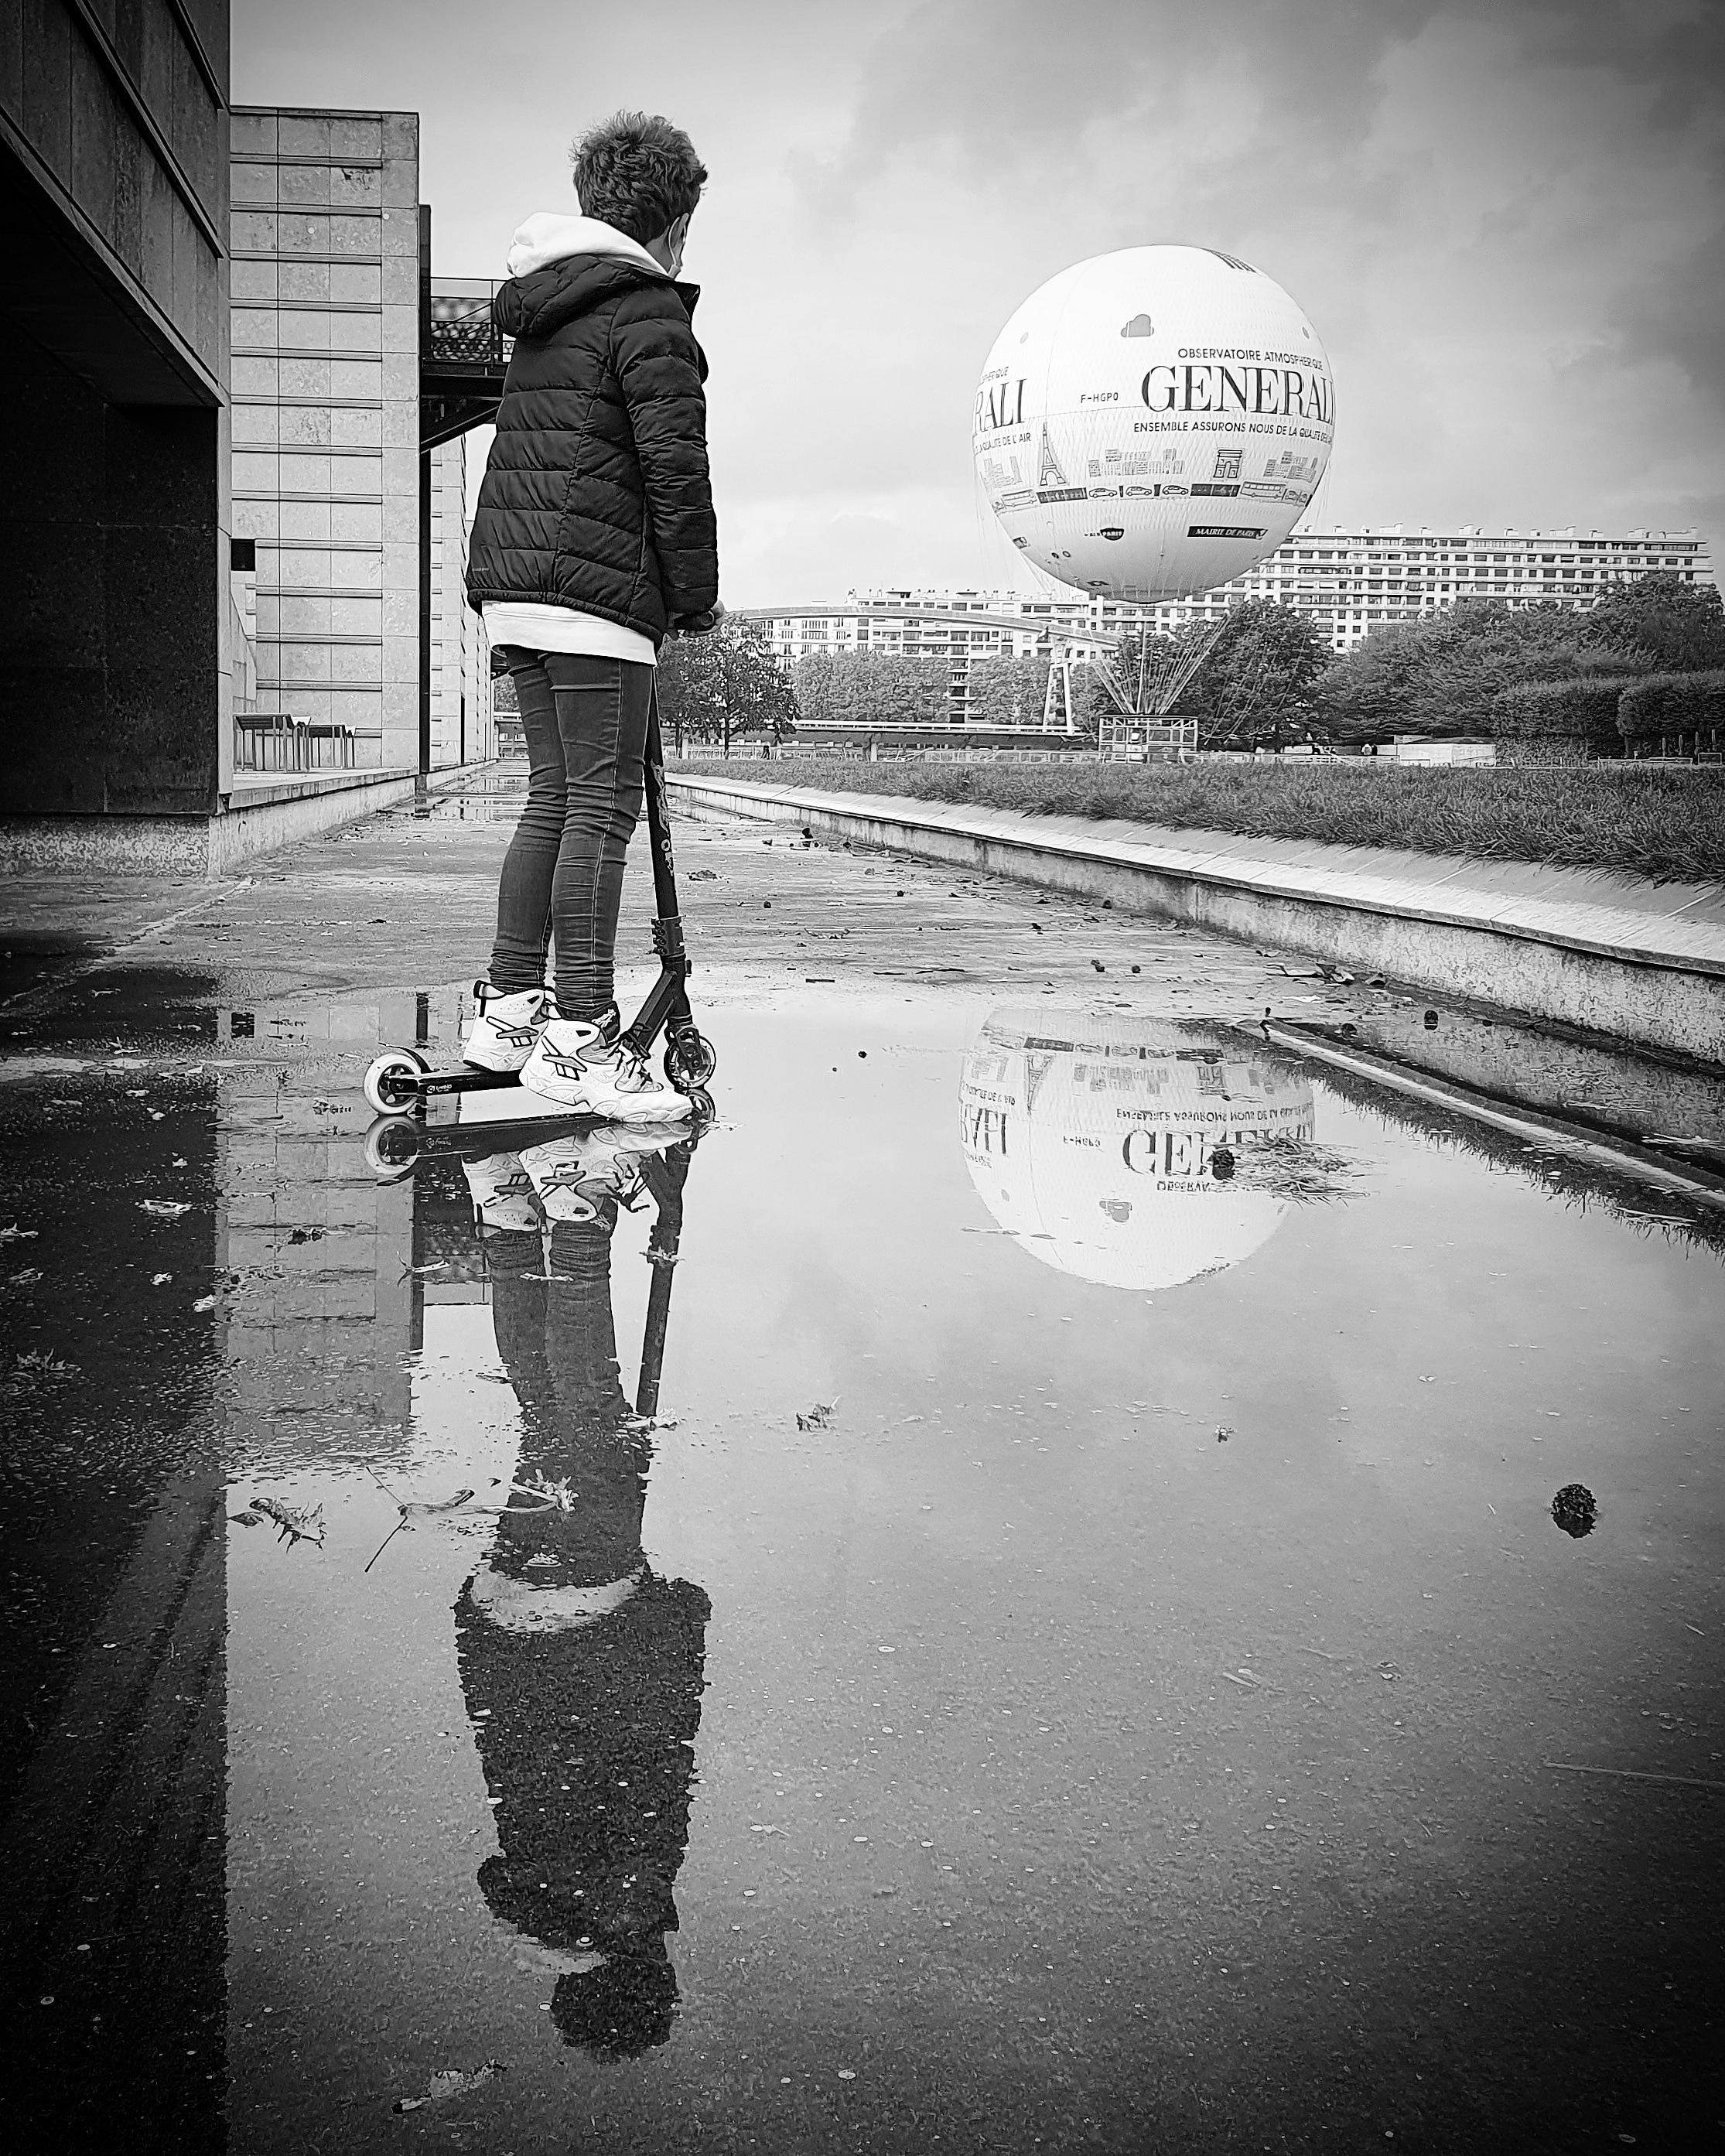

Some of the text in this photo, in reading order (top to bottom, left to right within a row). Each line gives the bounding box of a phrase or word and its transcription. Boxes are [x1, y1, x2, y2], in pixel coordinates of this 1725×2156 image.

[1177, 348, 1261, 360] OBSERVATOIRE
[1134, 422, 1188, 432] ENSEMBLE
[1191, 422, 1245, 432] ASSURONS
[1248, 423, 1274, 433] NOUS
[1276, 425, 1287, 435] DE
[1288, 426, 1297, 436] LA
